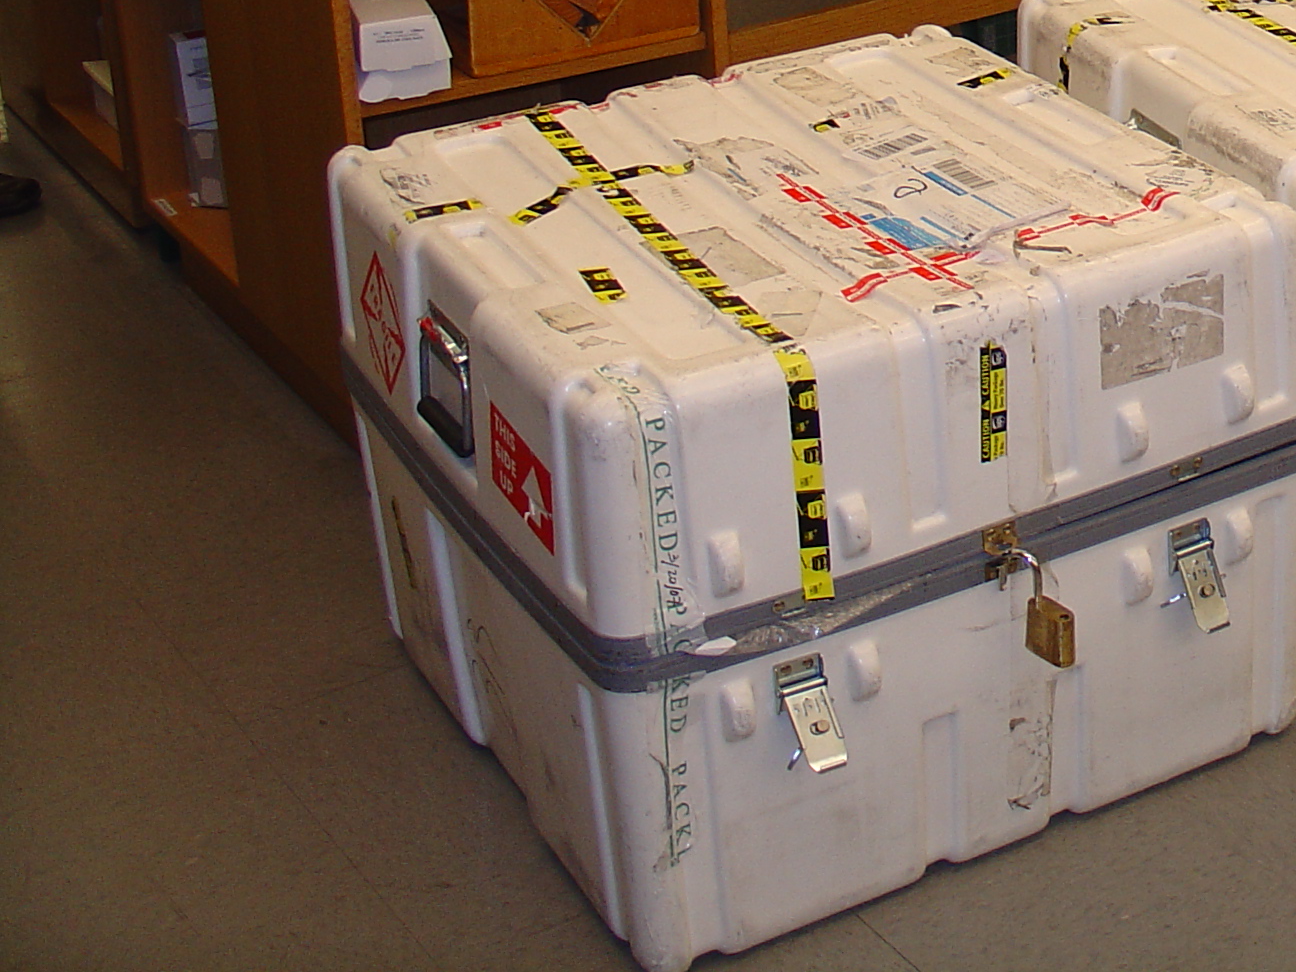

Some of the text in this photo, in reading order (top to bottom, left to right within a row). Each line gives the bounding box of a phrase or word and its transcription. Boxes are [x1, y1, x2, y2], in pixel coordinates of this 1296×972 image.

[982, 354, 990, 395] CAUTION
[493, 412, 516, 453] THIS
[982, 418, 990, 459] CAUTION
[494, 439, 517, 479] SIDE
[499, 470, 514, 495] UP
[645, 417, 679, 552] PACKED
